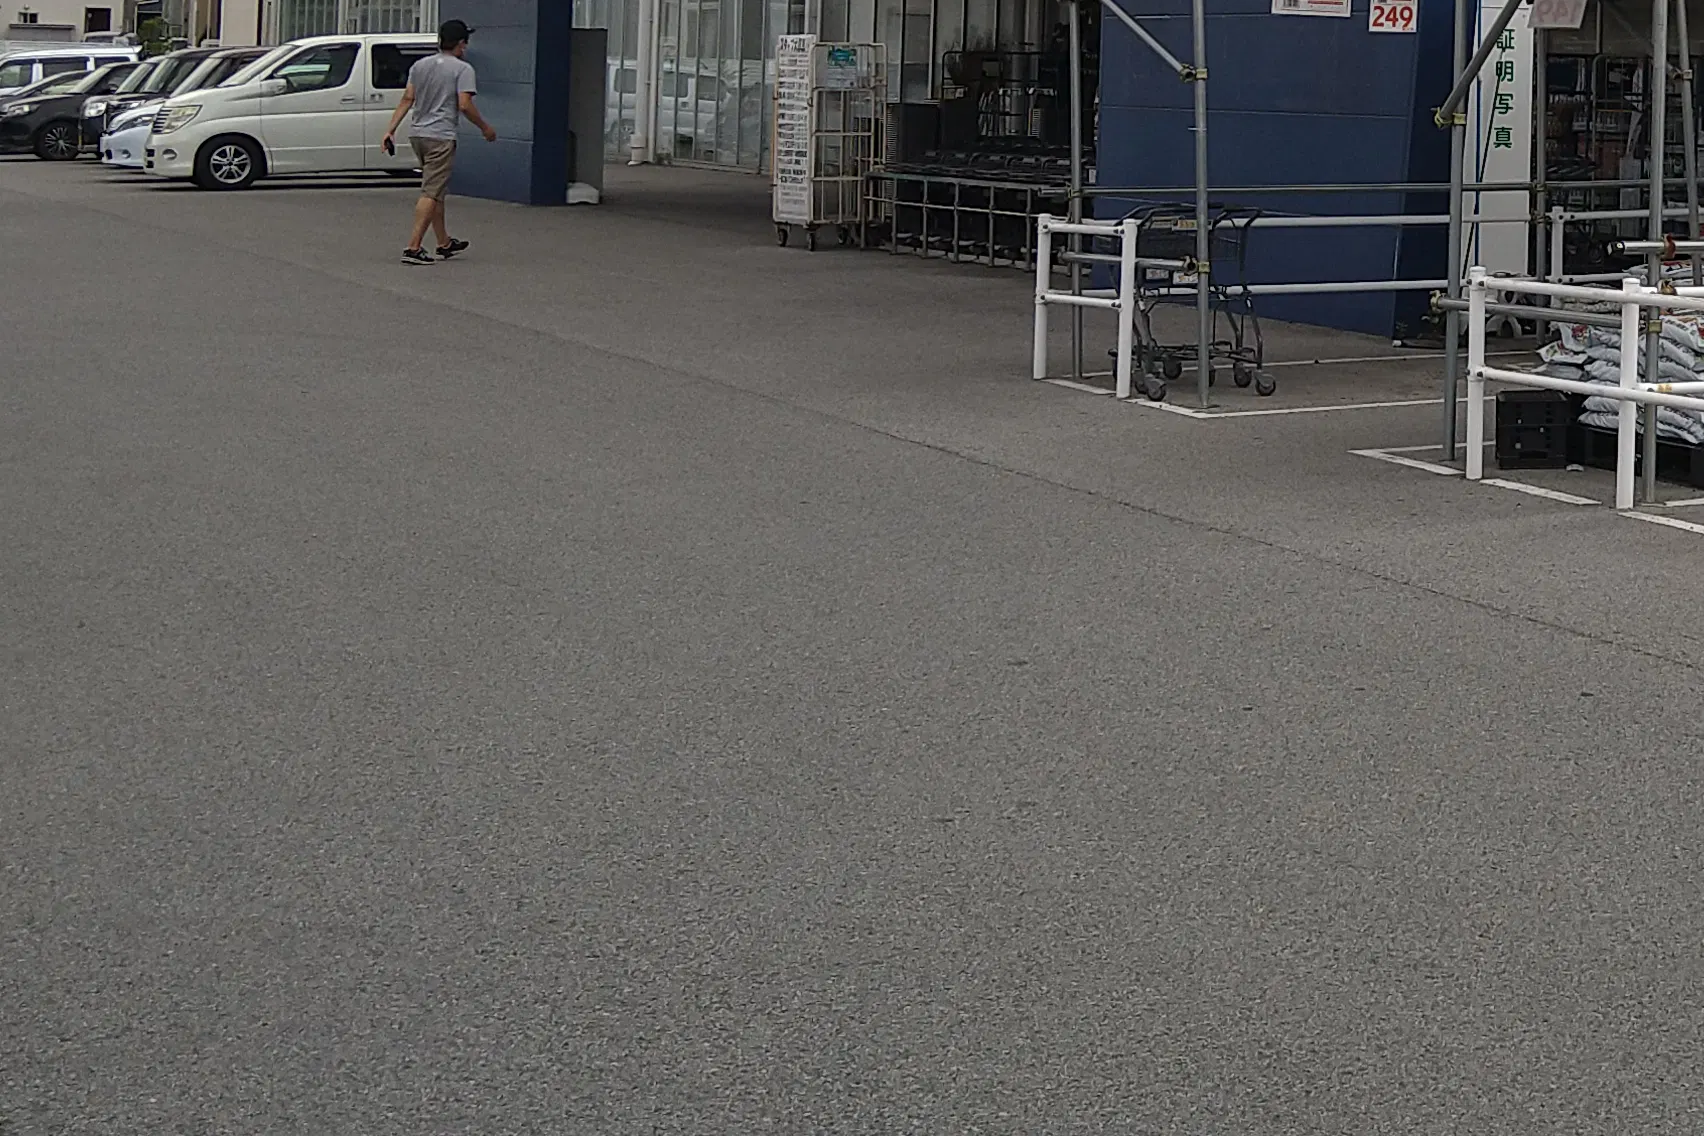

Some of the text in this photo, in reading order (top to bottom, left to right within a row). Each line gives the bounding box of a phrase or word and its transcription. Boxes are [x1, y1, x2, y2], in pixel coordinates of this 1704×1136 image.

[1372, 6, 1412, 28] 249
[1493, 28, 1515, 149] 証明写真
